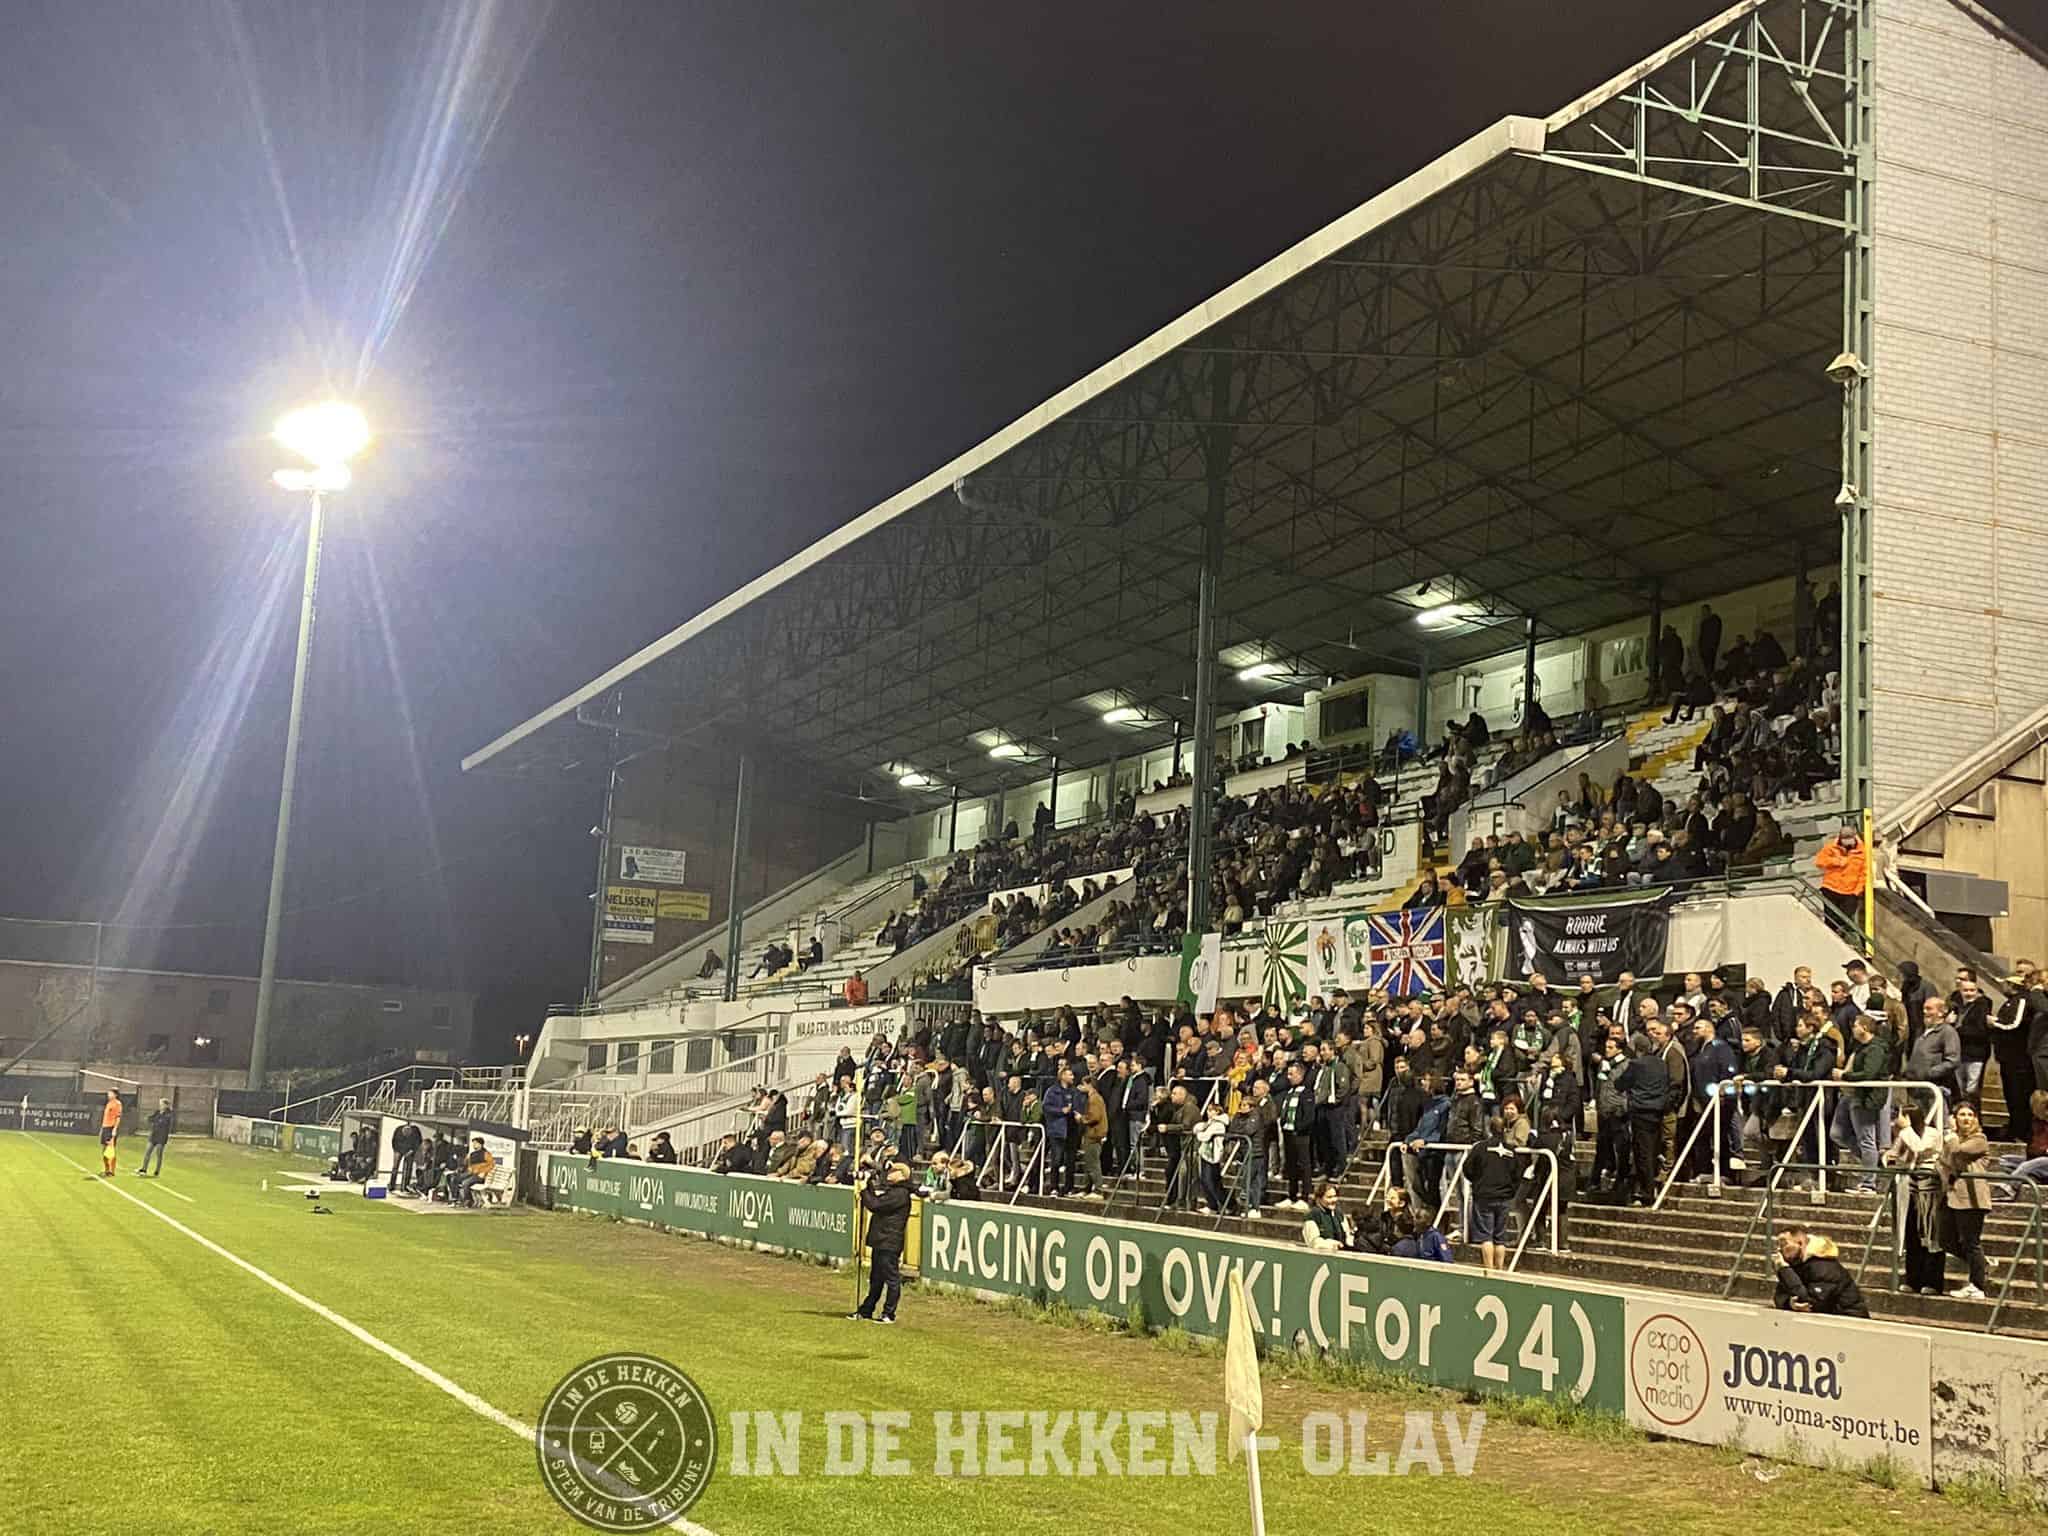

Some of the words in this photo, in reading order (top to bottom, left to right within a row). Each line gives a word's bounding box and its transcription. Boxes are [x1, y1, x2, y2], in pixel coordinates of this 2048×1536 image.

[1566, 915, 1607, 935] BOUGIE
[1553, 938, 1586, 954] ALWAYS
[1587, 937, 1608, 953] WITH
[1607, 937, 1620, 952] US
[1235, 955, 1248, 985] H
[629, 1175, 665, 1206] IMOYA
[729, 1188, 774, 1225] IMOYA
[788, 1206, 847, 1234] WWW.IMOYA.BE
[931, 1214, 1067, 1293] RACING
[1086, 1235, 1143, 1305] OP
[1162, 1246, 1283, 1337] OVK!
[1309, 1262, 1441, 1367] (For
[1473, 1294, 1597, 1404] 24)
[1647, 1327, 1691, 1360] expo
[1648, 1356, 1691, 1385] sport
[1645, 1384, 1694, 1411] media
[1724, 1395, 1920, 1447] www.joma-sport.be
